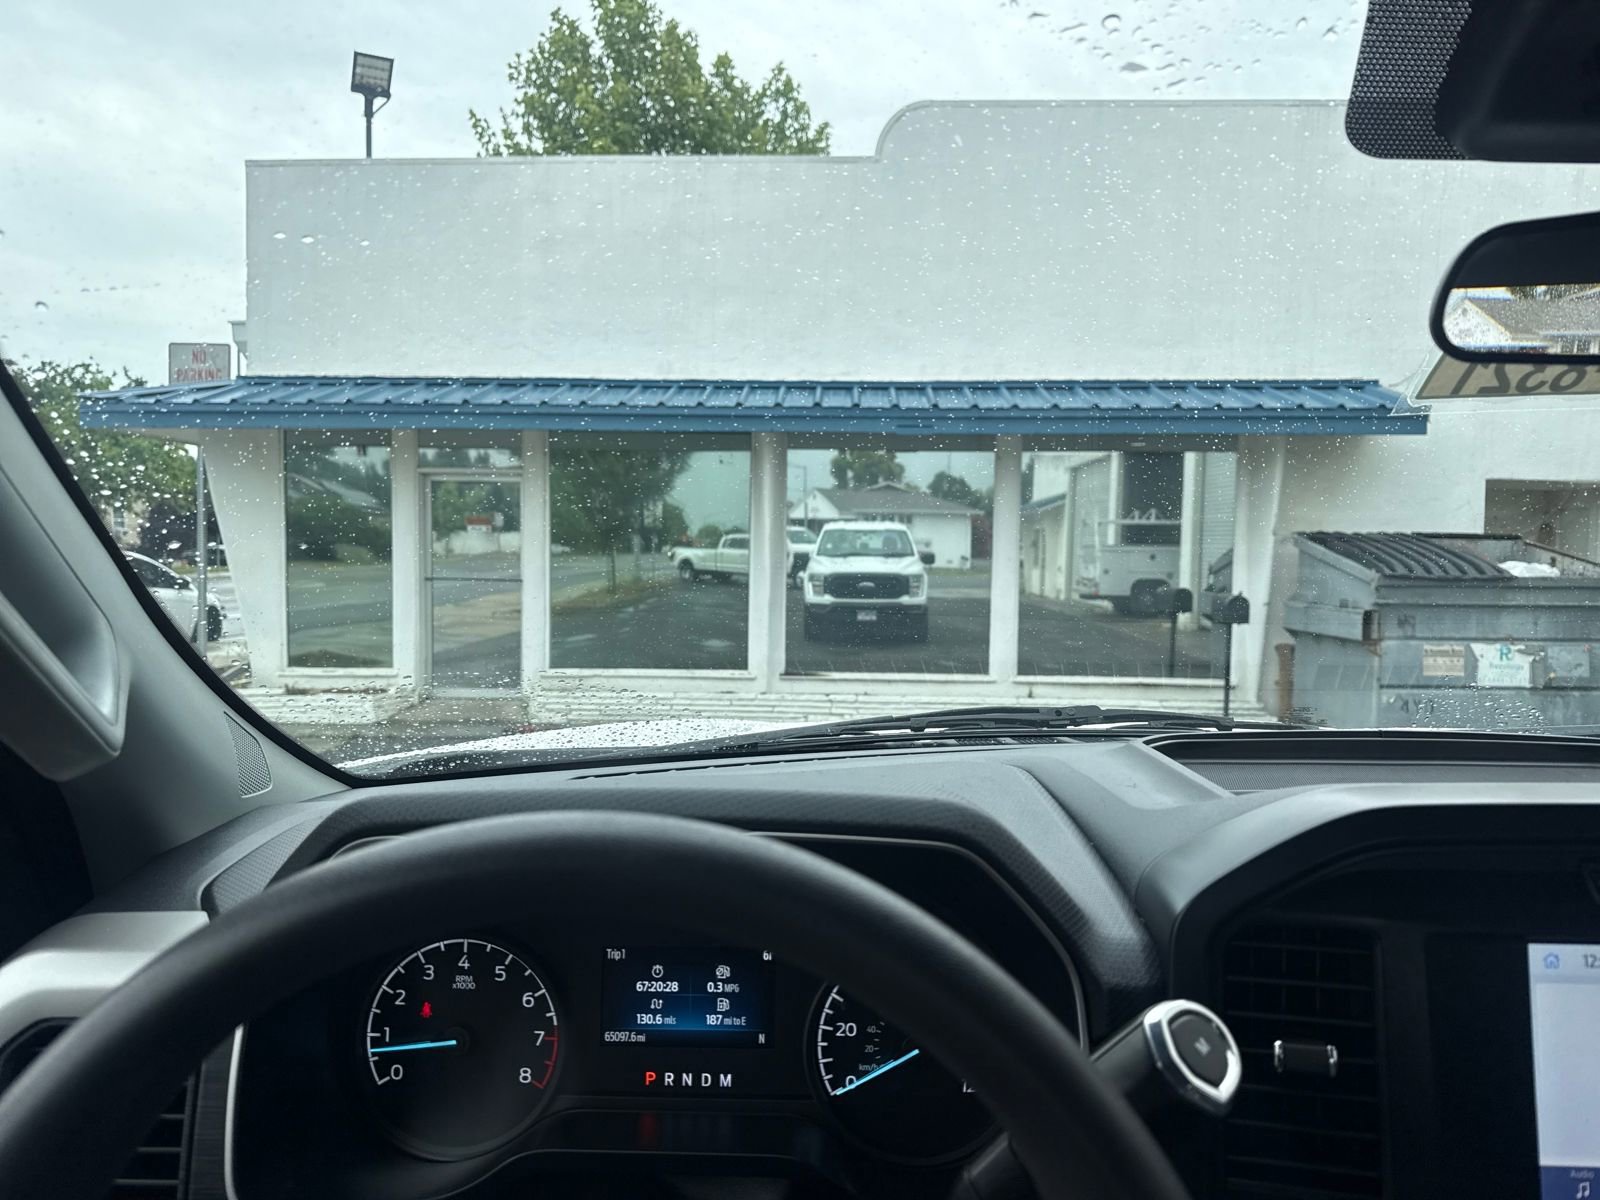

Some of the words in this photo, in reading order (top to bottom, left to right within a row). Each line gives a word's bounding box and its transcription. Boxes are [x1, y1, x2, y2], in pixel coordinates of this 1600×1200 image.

[191, 350, 207, 365] NO
[458, 954, 471, 970] 4
[423, 964, 435, 981] 3
[455, 974, 474, 983] RPM
[494, 965, 507, 982] 5
[452, 982, 476, 990] x1000
[636, 981, 679, 992] 67:20:28
[707, 982, 723, 993] 0.3
[724, 983, 740, 993] MPG
[394, 989, 406, 1006] 2
[522, 992, 535, 1008] 6
[636, 1013, 663, 1025] 130.6
[706, 1014, 723, 1026] 187
[741, 1016, 747, 1026] E
[383, 1026, 390, 1043] 1
[835, 1022, 857, 1037] 20
[866, 1025, 877, 1034] 40
[533, 1030, 546, 1047] 7
[758, 1033, 766, 1044] N
[864, 1044, 874, 1053] 20
[390, 1064, 404, 1081] 0
[518, 1067, 532, 1084] 8
[645, 1071, 657, 1086] P
[664, 1072, 675, 1087] R
[682, 1072, 693, 1087] N
[701, 1073, 712, 1087] D
[719, 1073, 732, 1088] M
